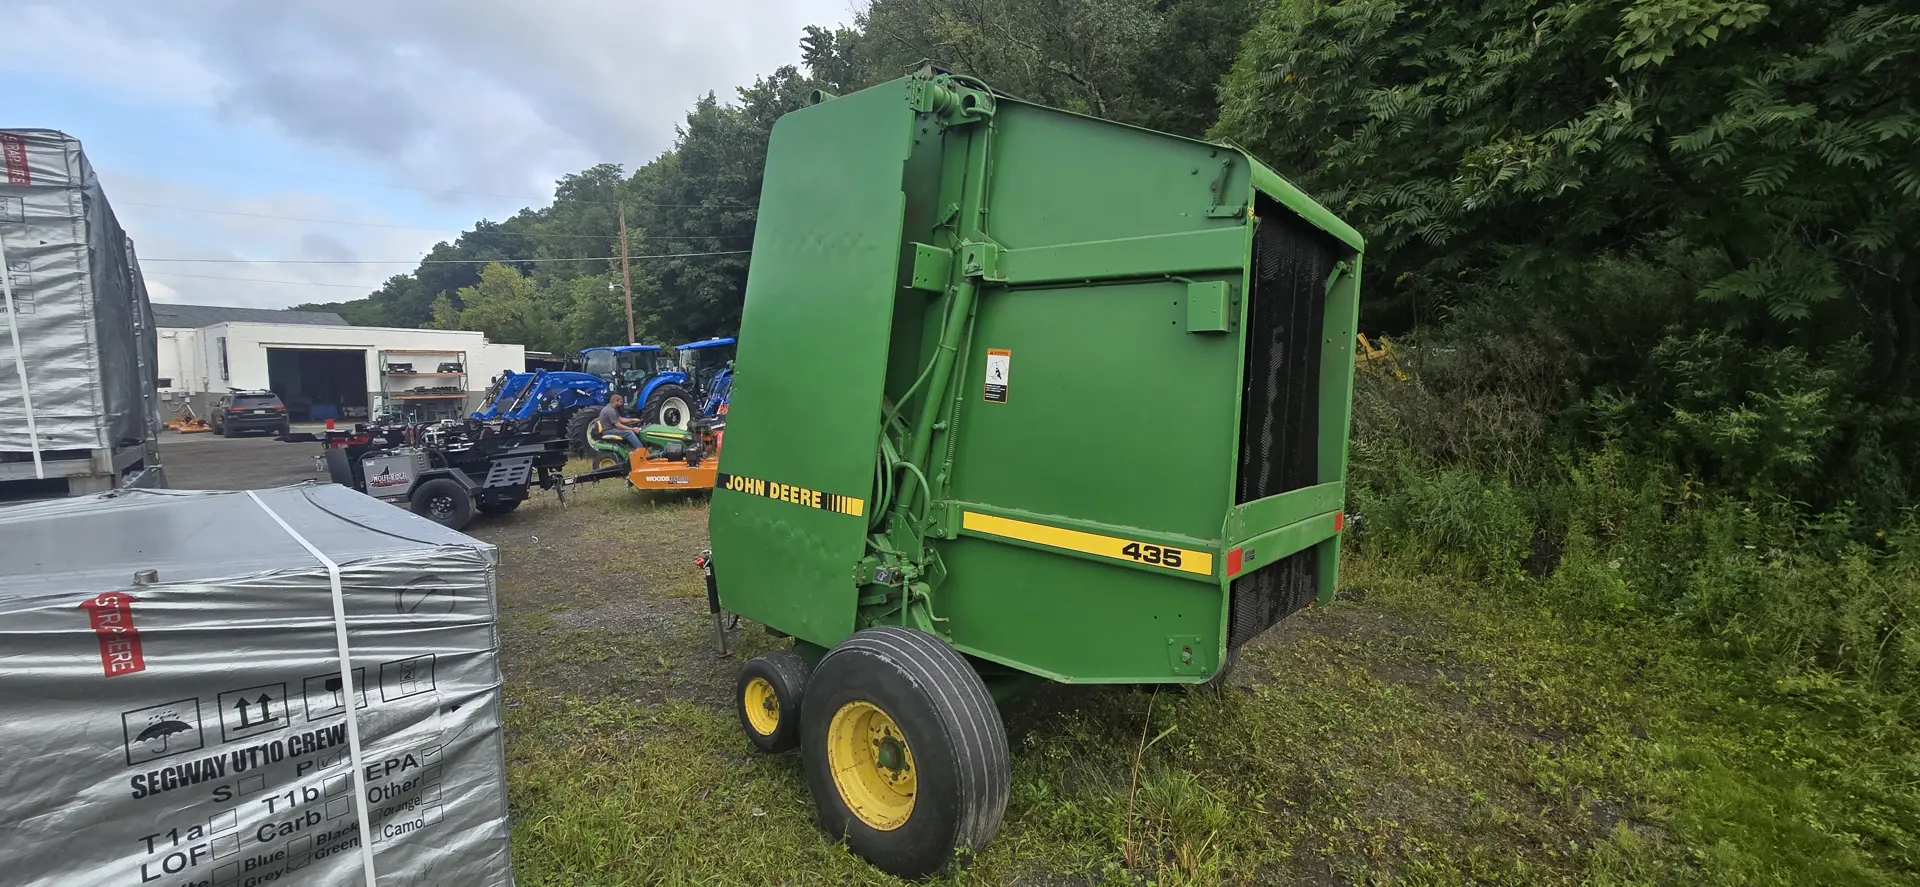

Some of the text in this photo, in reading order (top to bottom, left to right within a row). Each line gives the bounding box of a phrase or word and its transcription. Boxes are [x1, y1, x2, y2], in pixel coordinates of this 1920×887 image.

[726, 474, 822, 509] JOHN DEERE
[1122, 542, 1181, 567] 435
[130, 723, 346, 799] SEGWAY UT10 CREW
[296, 760, 313, 777] P
[366, 753, 420, 782] EPA
[212, 785, 233, 803] S
[262, 786, 319, 814] T1b
[367, 777, 420, 804] Other
[139, 824, 204, 855] T1a
[256, 810, 321, 843] Carb
[316, 822, 360, 846] Black
[383, 818, 424, 838] Camo
[244, 849, 285, 872] Blue
[314, 836, 358, 860] Green
[140, 843, 207, 883] LOF
[244, 866, 284, 887] Grey
